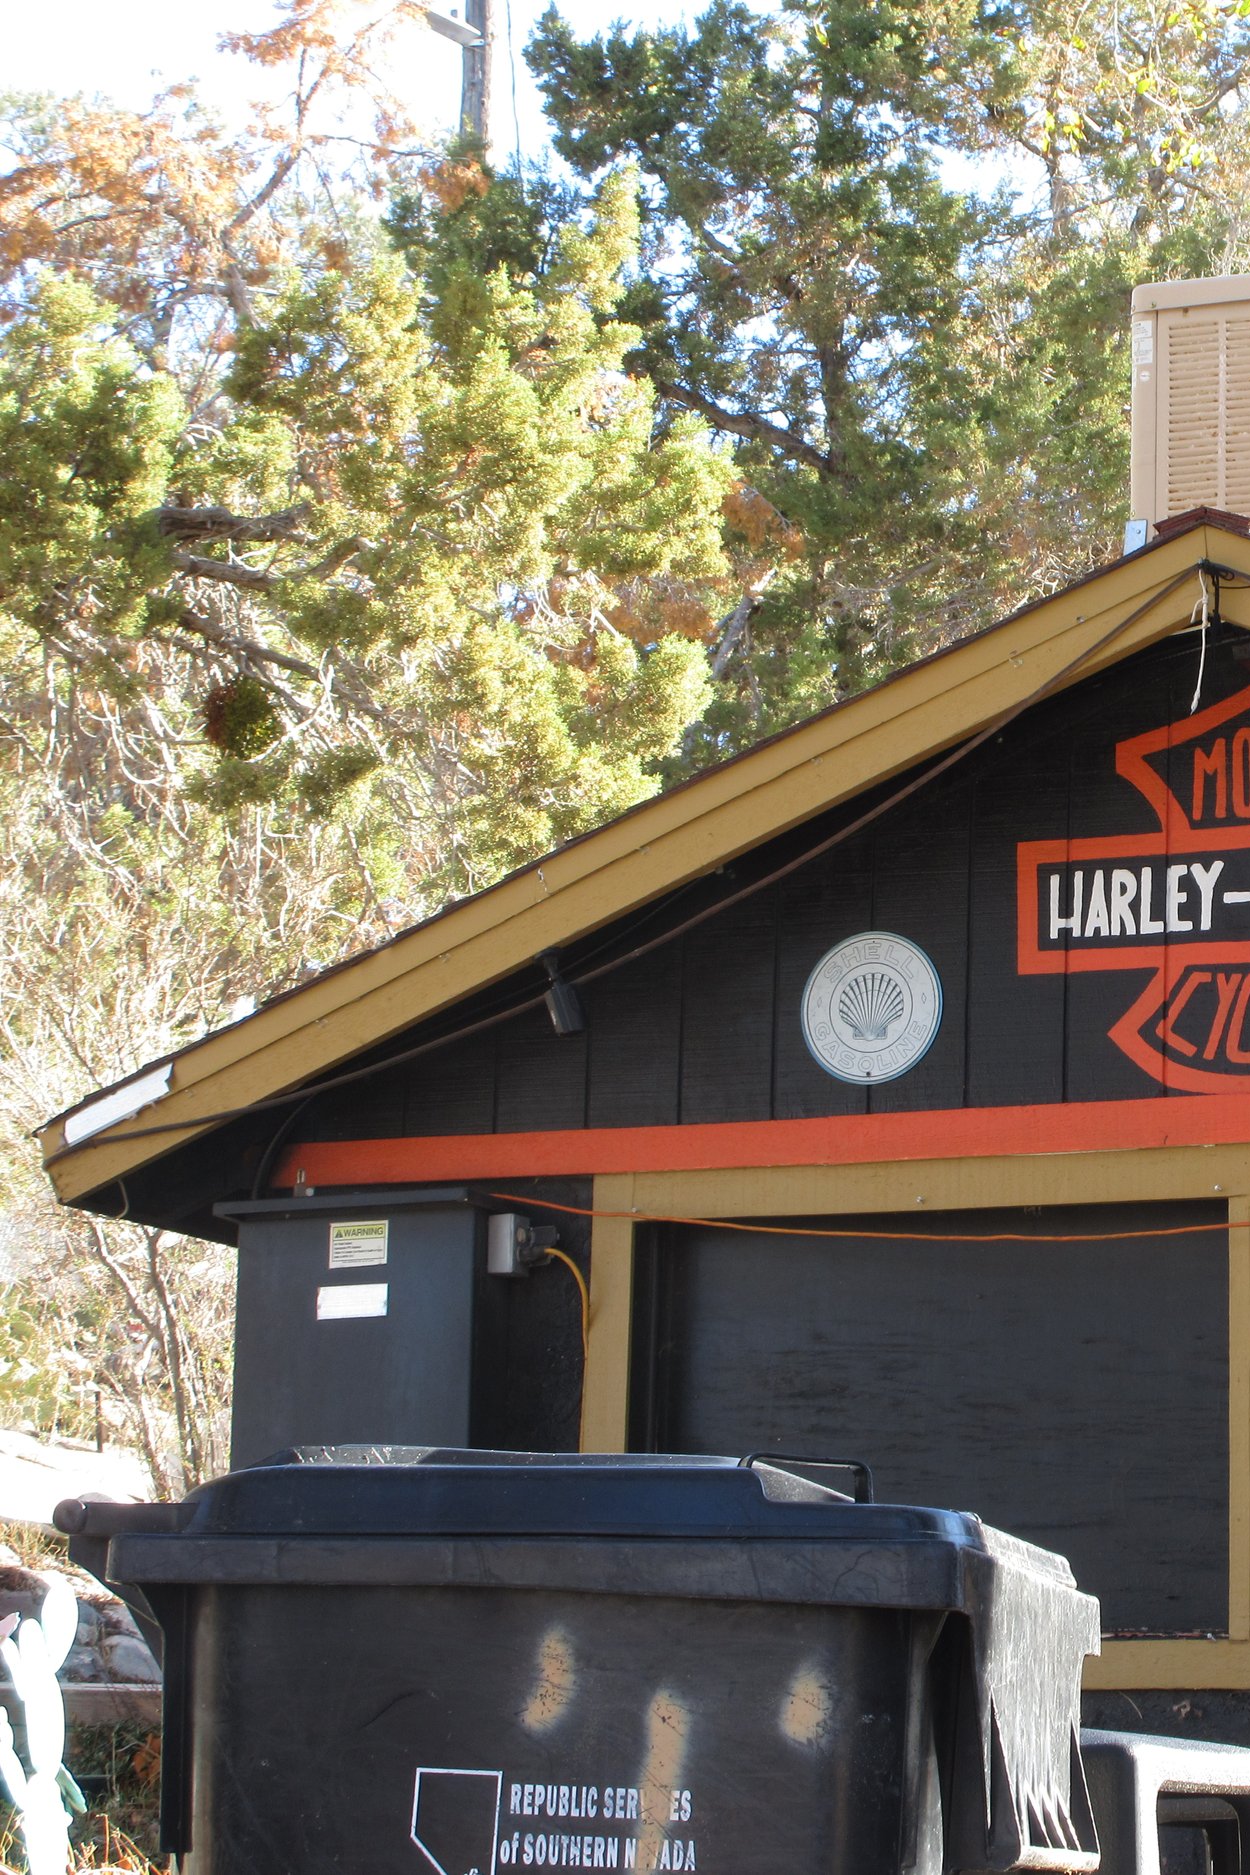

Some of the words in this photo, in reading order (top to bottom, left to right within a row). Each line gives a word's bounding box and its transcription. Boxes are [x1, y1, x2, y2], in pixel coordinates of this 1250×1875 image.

[823, 942, 915, 984] SHELL
[814, 1020, 927, 1074] GASOLINE
[343, 1226, 384, 1238] WARNING
[510, 1783, 598, 1818] REPUBLIC
[602, 1787, 692, 1821] SERES
[500, 1832, 520, 1865] of
[522, 1833, 619, 1867] SOUTHERN
[623, 1837, 696, 1871] NADA
